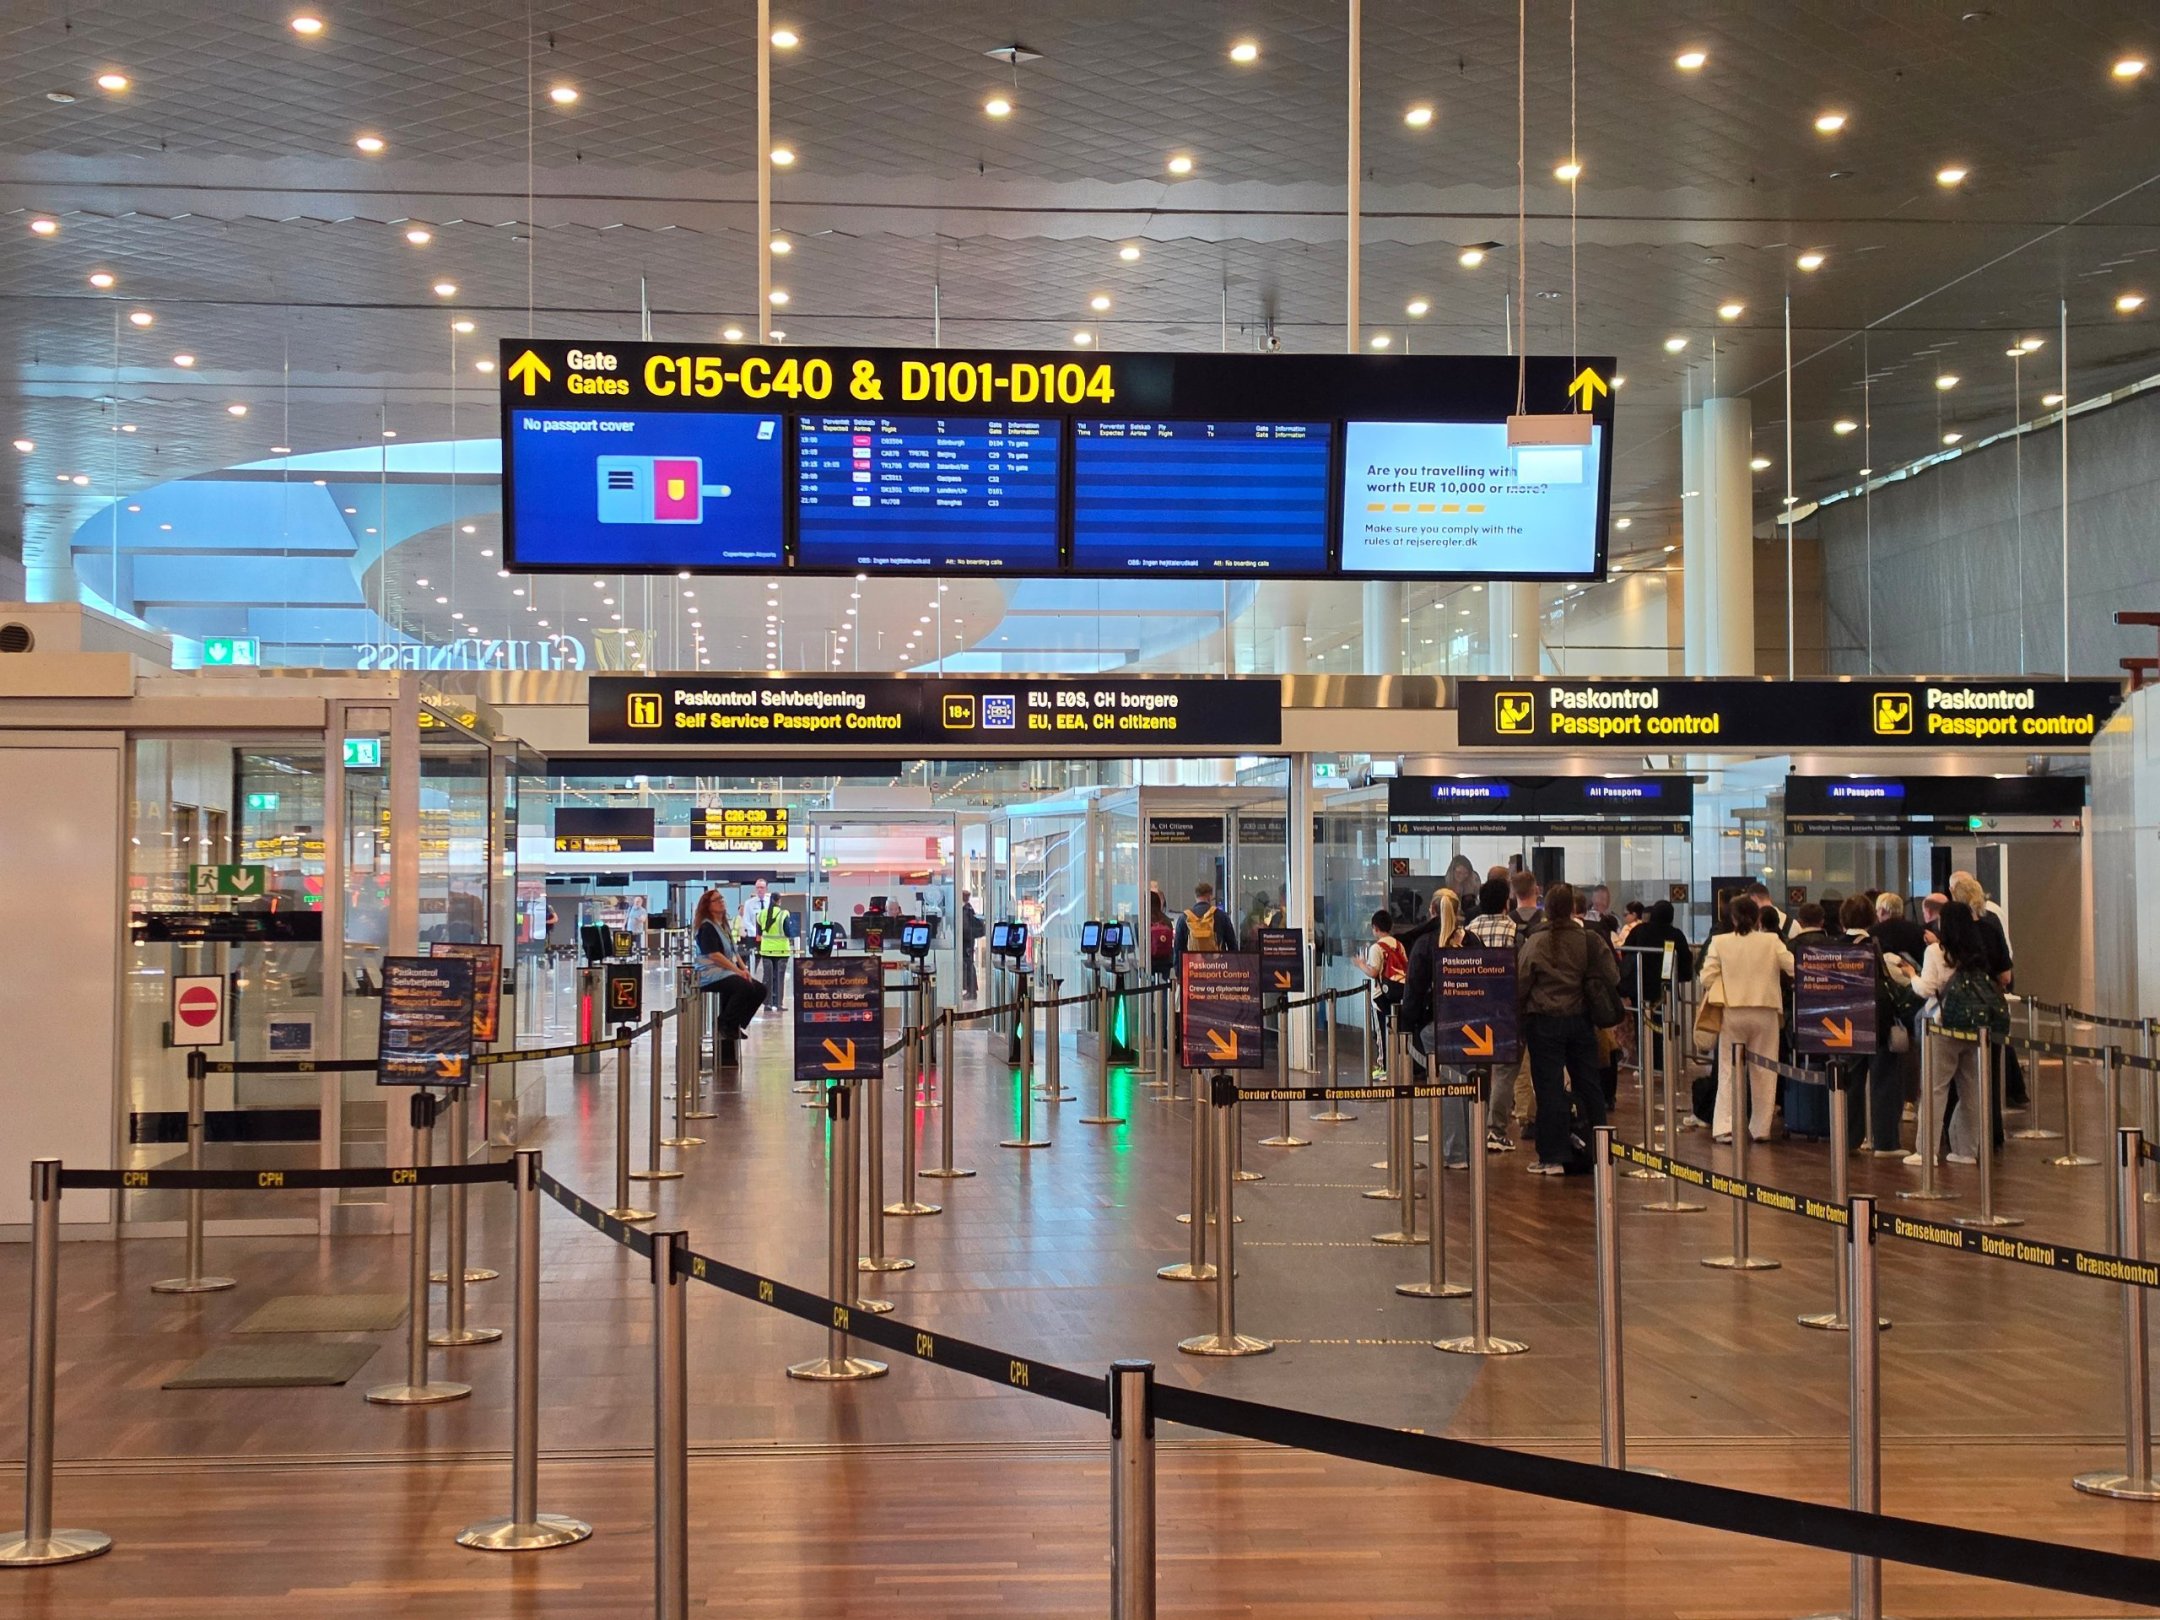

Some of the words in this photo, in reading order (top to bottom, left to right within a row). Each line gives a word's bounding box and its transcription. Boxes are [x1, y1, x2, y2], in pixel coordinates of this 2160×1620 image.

[567, 350, 617, 370] Gate
[567, 374, 630, 395] Gates
[644, 355, 833, 398] C15-C40
[850, 364, 884, 400] &
[902, 361, 1114, 404] D101-D104
[524, 418, 541, 430] No
[543, 420, 598, 433] passport
[600, 421, 635, 432] cover
[937, 439, 965, 447] Edinburgh
[1368, 465, 1390, 476] Are
[1394, 468, 1417, 480] you
[1422, 464, 1485, 480] travelling
[1368, 482, 1405, 494] worth
[1410, 483, 1435, 494] EUR
[1441, 484, 1486, 496] 10,000
[1490, 486, 1502, 494] or
[1366, 524, 1392, 534] Make
[1395, 526, 1418, 534] sure
[1421, 527, 1438, 538] you
[1442, 524, 1478, 538] comply
[1482, 526, 1504, 535] with
[1507, 526, 1523, 535] the
[1364, 537, 1390, 546] rules
[1394, 538, 1404, 546] at
[1406, 538, 1478, 548] rejseregler.dk
[674, 690, 757, 707] Paskontrol
[761, 691, 866, 709] Selvbetjening
[1028, 692, 1051, 709] EU,
[1056, 692, 1089, 709] EØS,
[1094, 692, 1116, 707] CH
[1121, 692, 1178, 710] borgere
[1550, 688, 1659, 709] Paskontrol
[1928, 688, 2034, 709] Paskontrol
[949, 705, 971, 719] 18+
[674, 713, 706, 728] Self
[710, 714, 769, 729] Service
[774, 714, 841, 731] Passport
[846, 714, 901, 729] Control
[1028, 714, 1051, 731] EU,
[1056, 714, 1088, 731] EEA,
[1094, 714, 1115, 729] CH
[1120, 714, 1177, 729] citizens
[1550, 714, 1641, 737] Passport
[1647, 713, 1720, 734] control
[1928, 714, 2017, 738] Passport
[2022, 714, 2093, 734] control
[1438, 787, 1449, 796] All
[1451, 788, 1490, 797] Passports
[1590, 787, 1601, 796] All
[1603, 788, 1642, 798] Passports
[1834, 788, 1845, 796] All
[1846, 788, 1885, 798] Passports
[1398, 824, 1408, 834] 14
[1673, 824, 1684, 833] 15
[1794, 824, 1804, 833] 16
[705, 839, 729, 850] Pearl
[730, 839, 764, 852] Lounge
[1442, 957, 1482, 966] Paskontrol
[1803, 954, 1841, 962] Paskontrol
[1189, 962, 1228, 970] Paskontrol
[1442, 966, 1476, 975] Passport
[1478, 966, 1505, 974] Control
[1803, 962, 1836, 971] Passport
[1836, 962, 1864, 970] Control
[392, 968, 438, 977] Paskontrol
[804, 968, 845, 976] Paskontrol
[1189, 970, 1221, 980] Passport
[1223, 970, 1250, 978] Control
[392, 978, 450, 988] Selvbetjening
[804, 978, 838, 986] Passport
[840, 976, 869, 985] Control
[1456, 982, 1469, 990] pas
[1207, 986, 1215, 994] og
[1216, 985, 1249, 994] diplomater
[1813, 983, 1845, 991] Passports
[832, 992, 842, 1000] CH
[1220, 994, 1251, 1002] Diplomats
[1453, 989, 1485, 997] Passports
[392, 1000, 429, 1008] Passport
[217, 1063, 233, 1072] CPH
[298, 1063, 315, 1072] CPH
[1238, 1090, 1270, 1100] Border
[1271, 1090, 1306, 1100] Control
[1326, 1088, 1395, 1100] Grænsekontrol
[1414, 1086, 1446, 1097] Border
[124, 1172, 148, 1186] CPH
[258, 1172, 284, 1186] CPH
[392, 1170, 417, 1184] CPH
[1632, 1148, 1646, 1163] Border
[1646, 1152, 1663, 1170] Control
[1670, 1160, 1703, 1185] Grænsekontrol
[1712, 1174, 1728, 1193] Border
[1728, 1179, 1747, 1199] Control
[1756, 1188, 1796, 1211] Grænsekontrol
[1806, 1199, 1826, 1219] Border
[1826, 1204, 1848, 1225] Control
[1895, 1217, 1962, 1248] Grænsekontrol
[1982, 1235, 2015, 1258] Border
[2016, 1242, 2055, 1266] Control
[2076, 1252, 2159, 1286] Grænsekontrol
[692, 1257, 706, 1278] CPH
[760, 1280, 774, 1303] CPH
[834, 1306, 849, 1330] CPH
[917, 1333, 934, 1359] CPH
[1010, 1360, 1029, 1387] CPH
